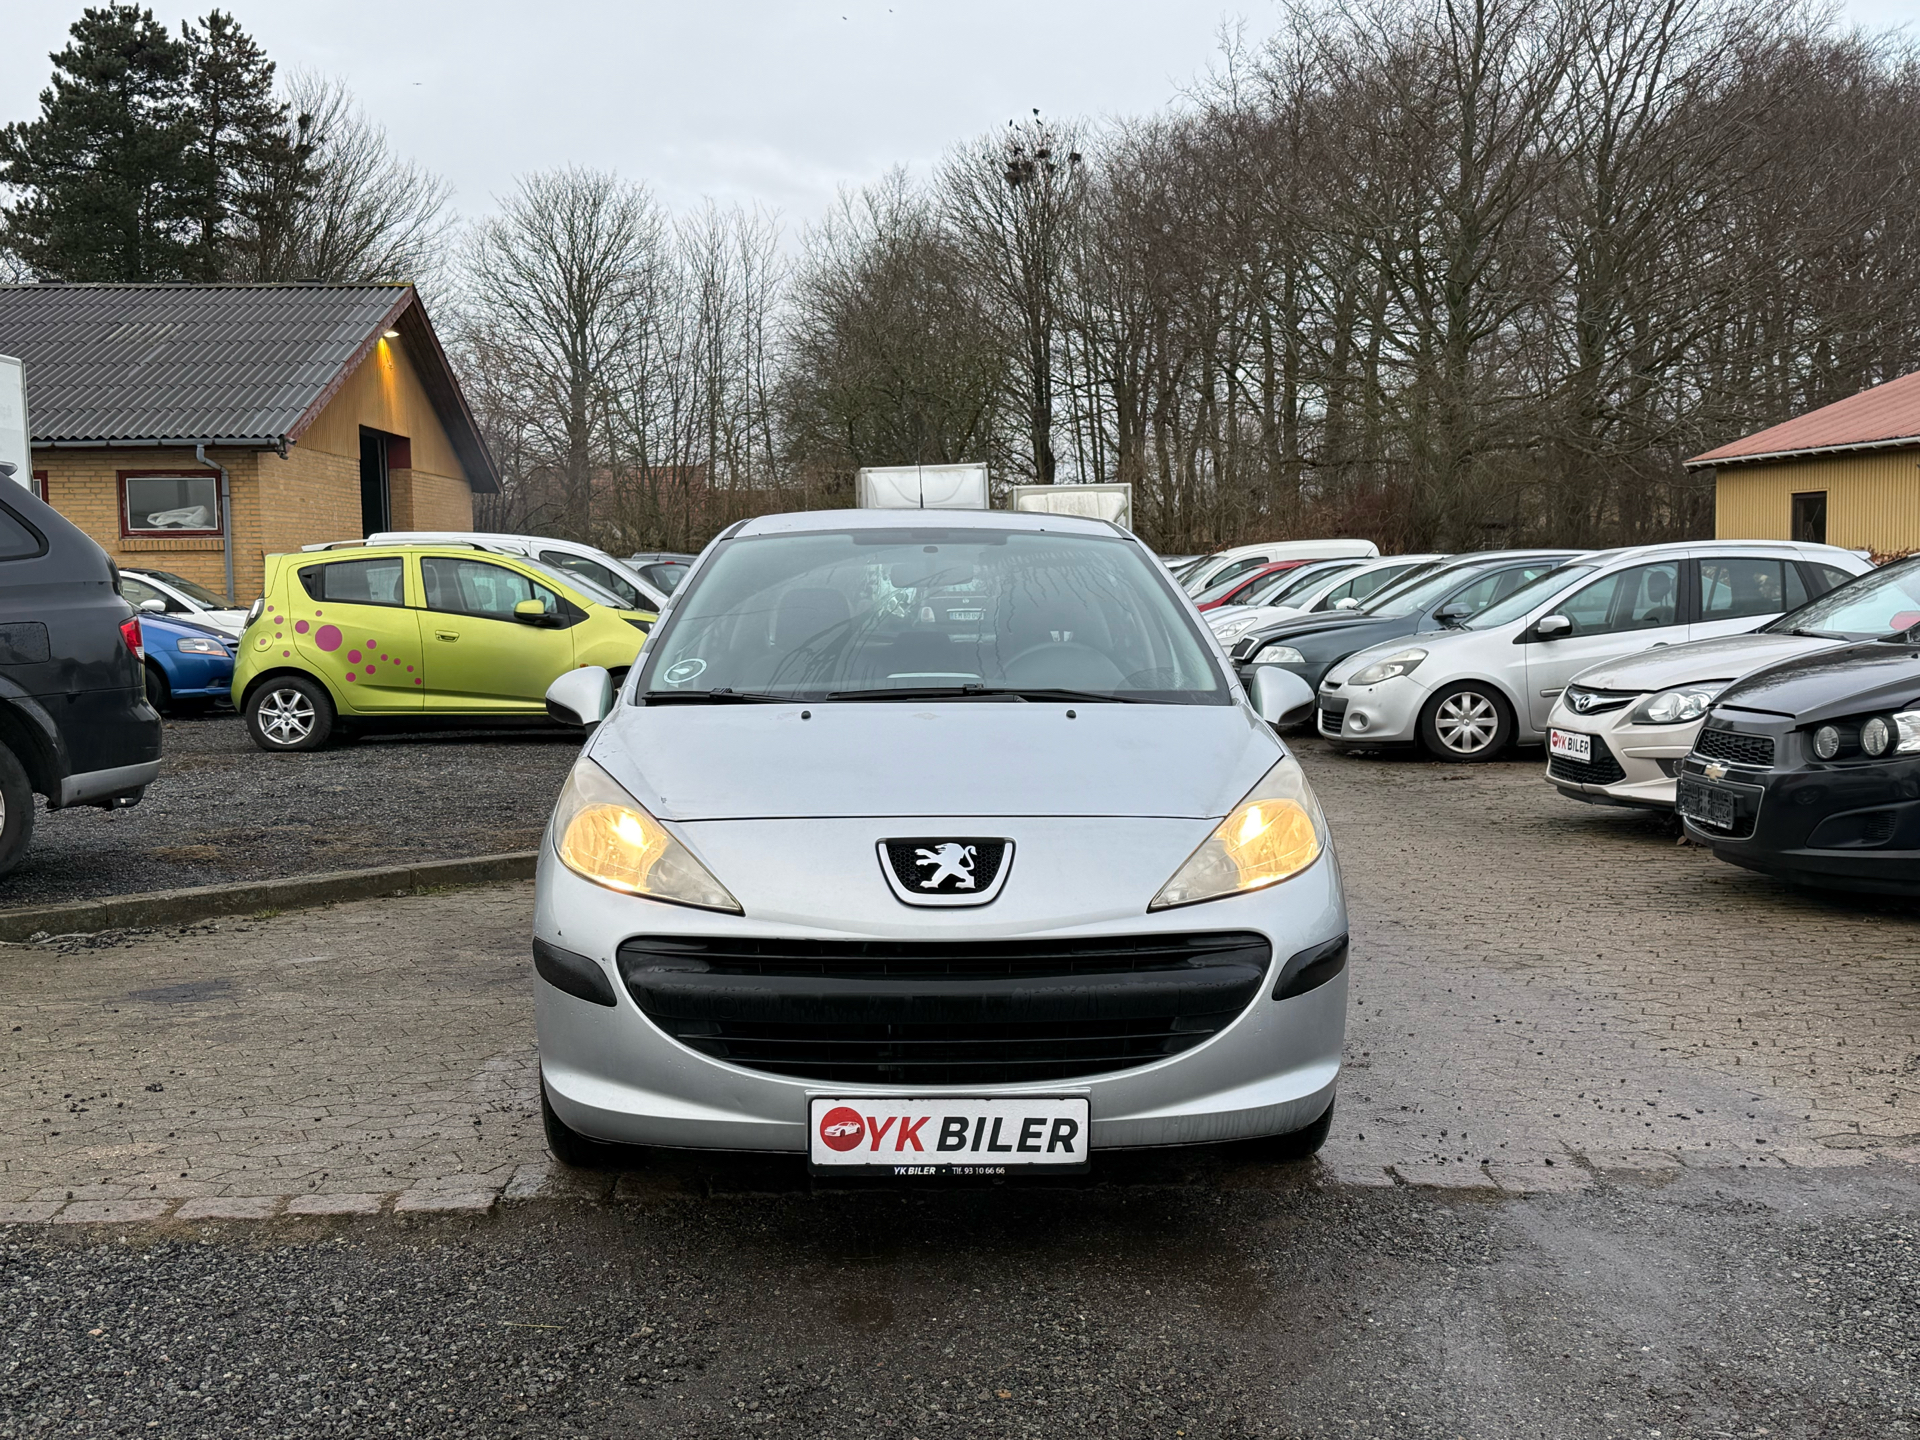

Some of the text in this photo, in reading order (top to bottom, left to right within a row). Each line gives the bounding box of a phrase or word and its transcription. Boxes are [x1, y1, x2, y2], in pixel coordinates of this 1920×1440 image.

[1557, 735, 1589, 754] YK BILER
[866, 1116, 1079, 1153] YK BILER
[894, 1167, 1005, 1175] YK BILER Tlf. 93 10 66 66
